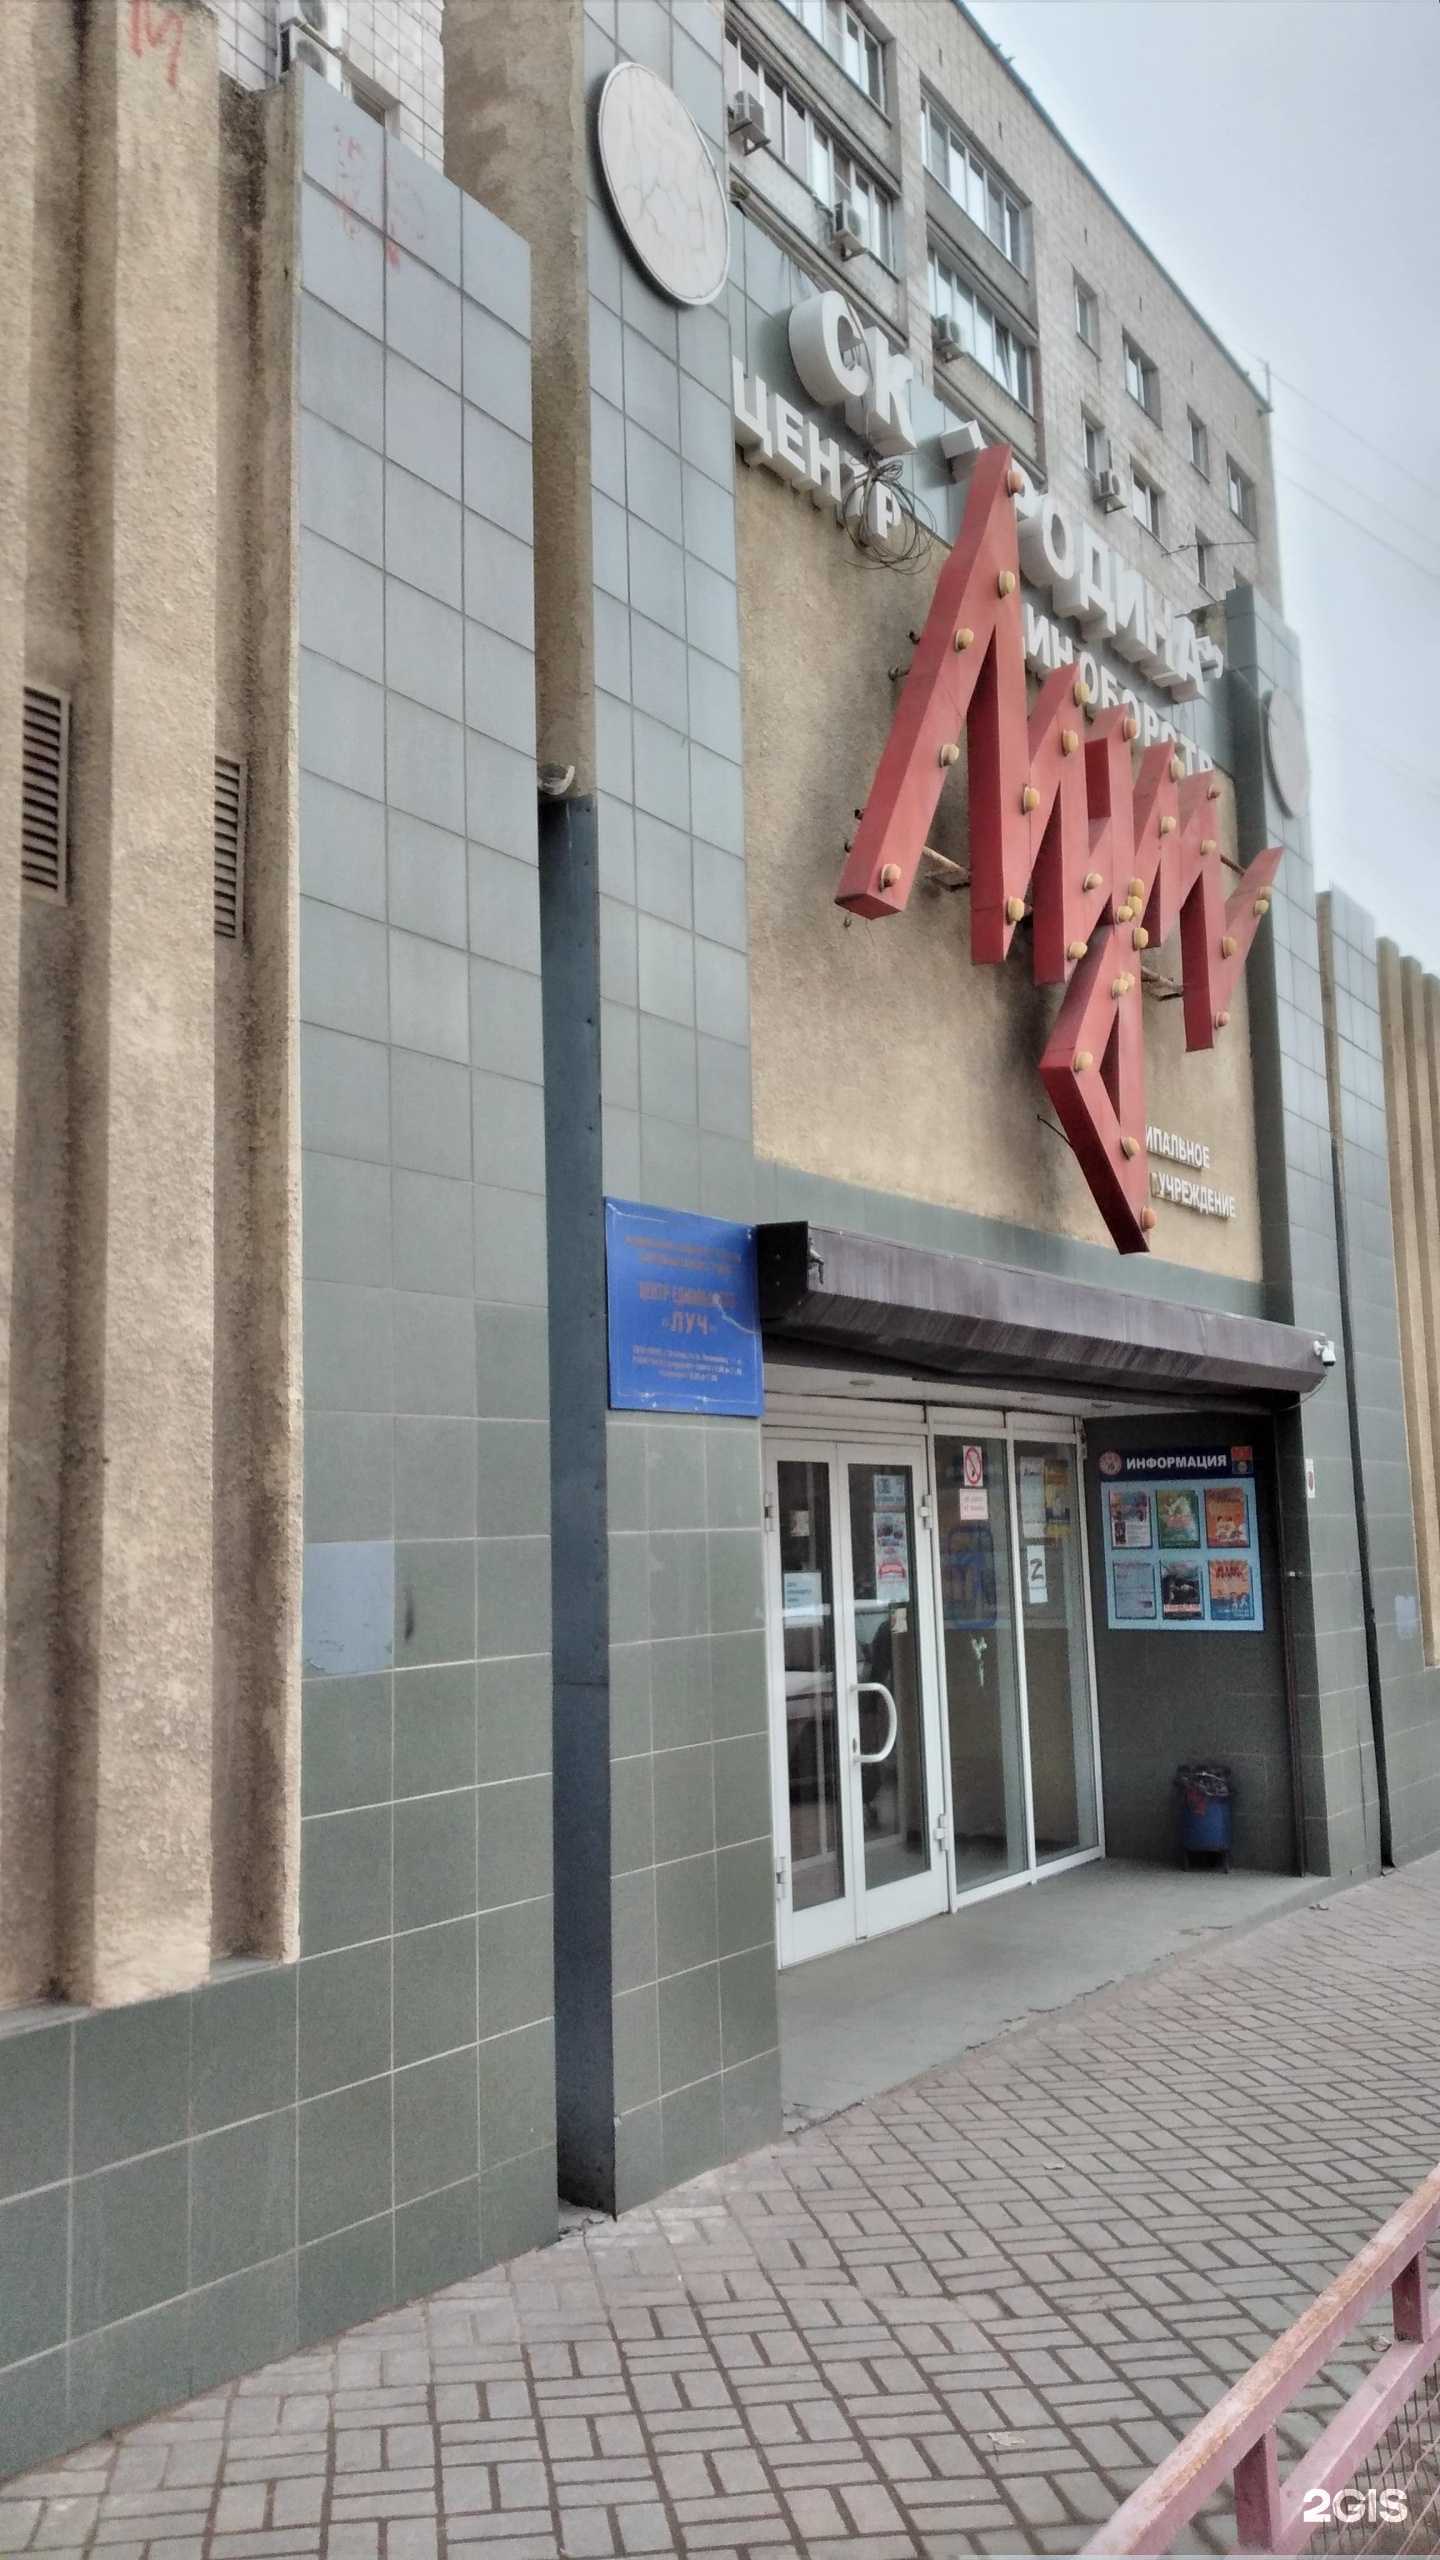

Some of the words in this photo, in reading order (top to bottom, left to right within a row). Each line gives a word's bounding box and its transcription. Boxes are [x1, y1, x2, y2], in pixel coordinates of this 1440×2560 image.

[789, 290, 917, 455] СК
[732, 354, 903, 541] ЦЕНТР
[1158, 1172, 1237, 1218] УЧРЕЖДЕНИЕ
[1126, 1455, 1227, 1471] ИНФОРМАЦИЯ
[1030, 1558, 1045, 1582] 2
